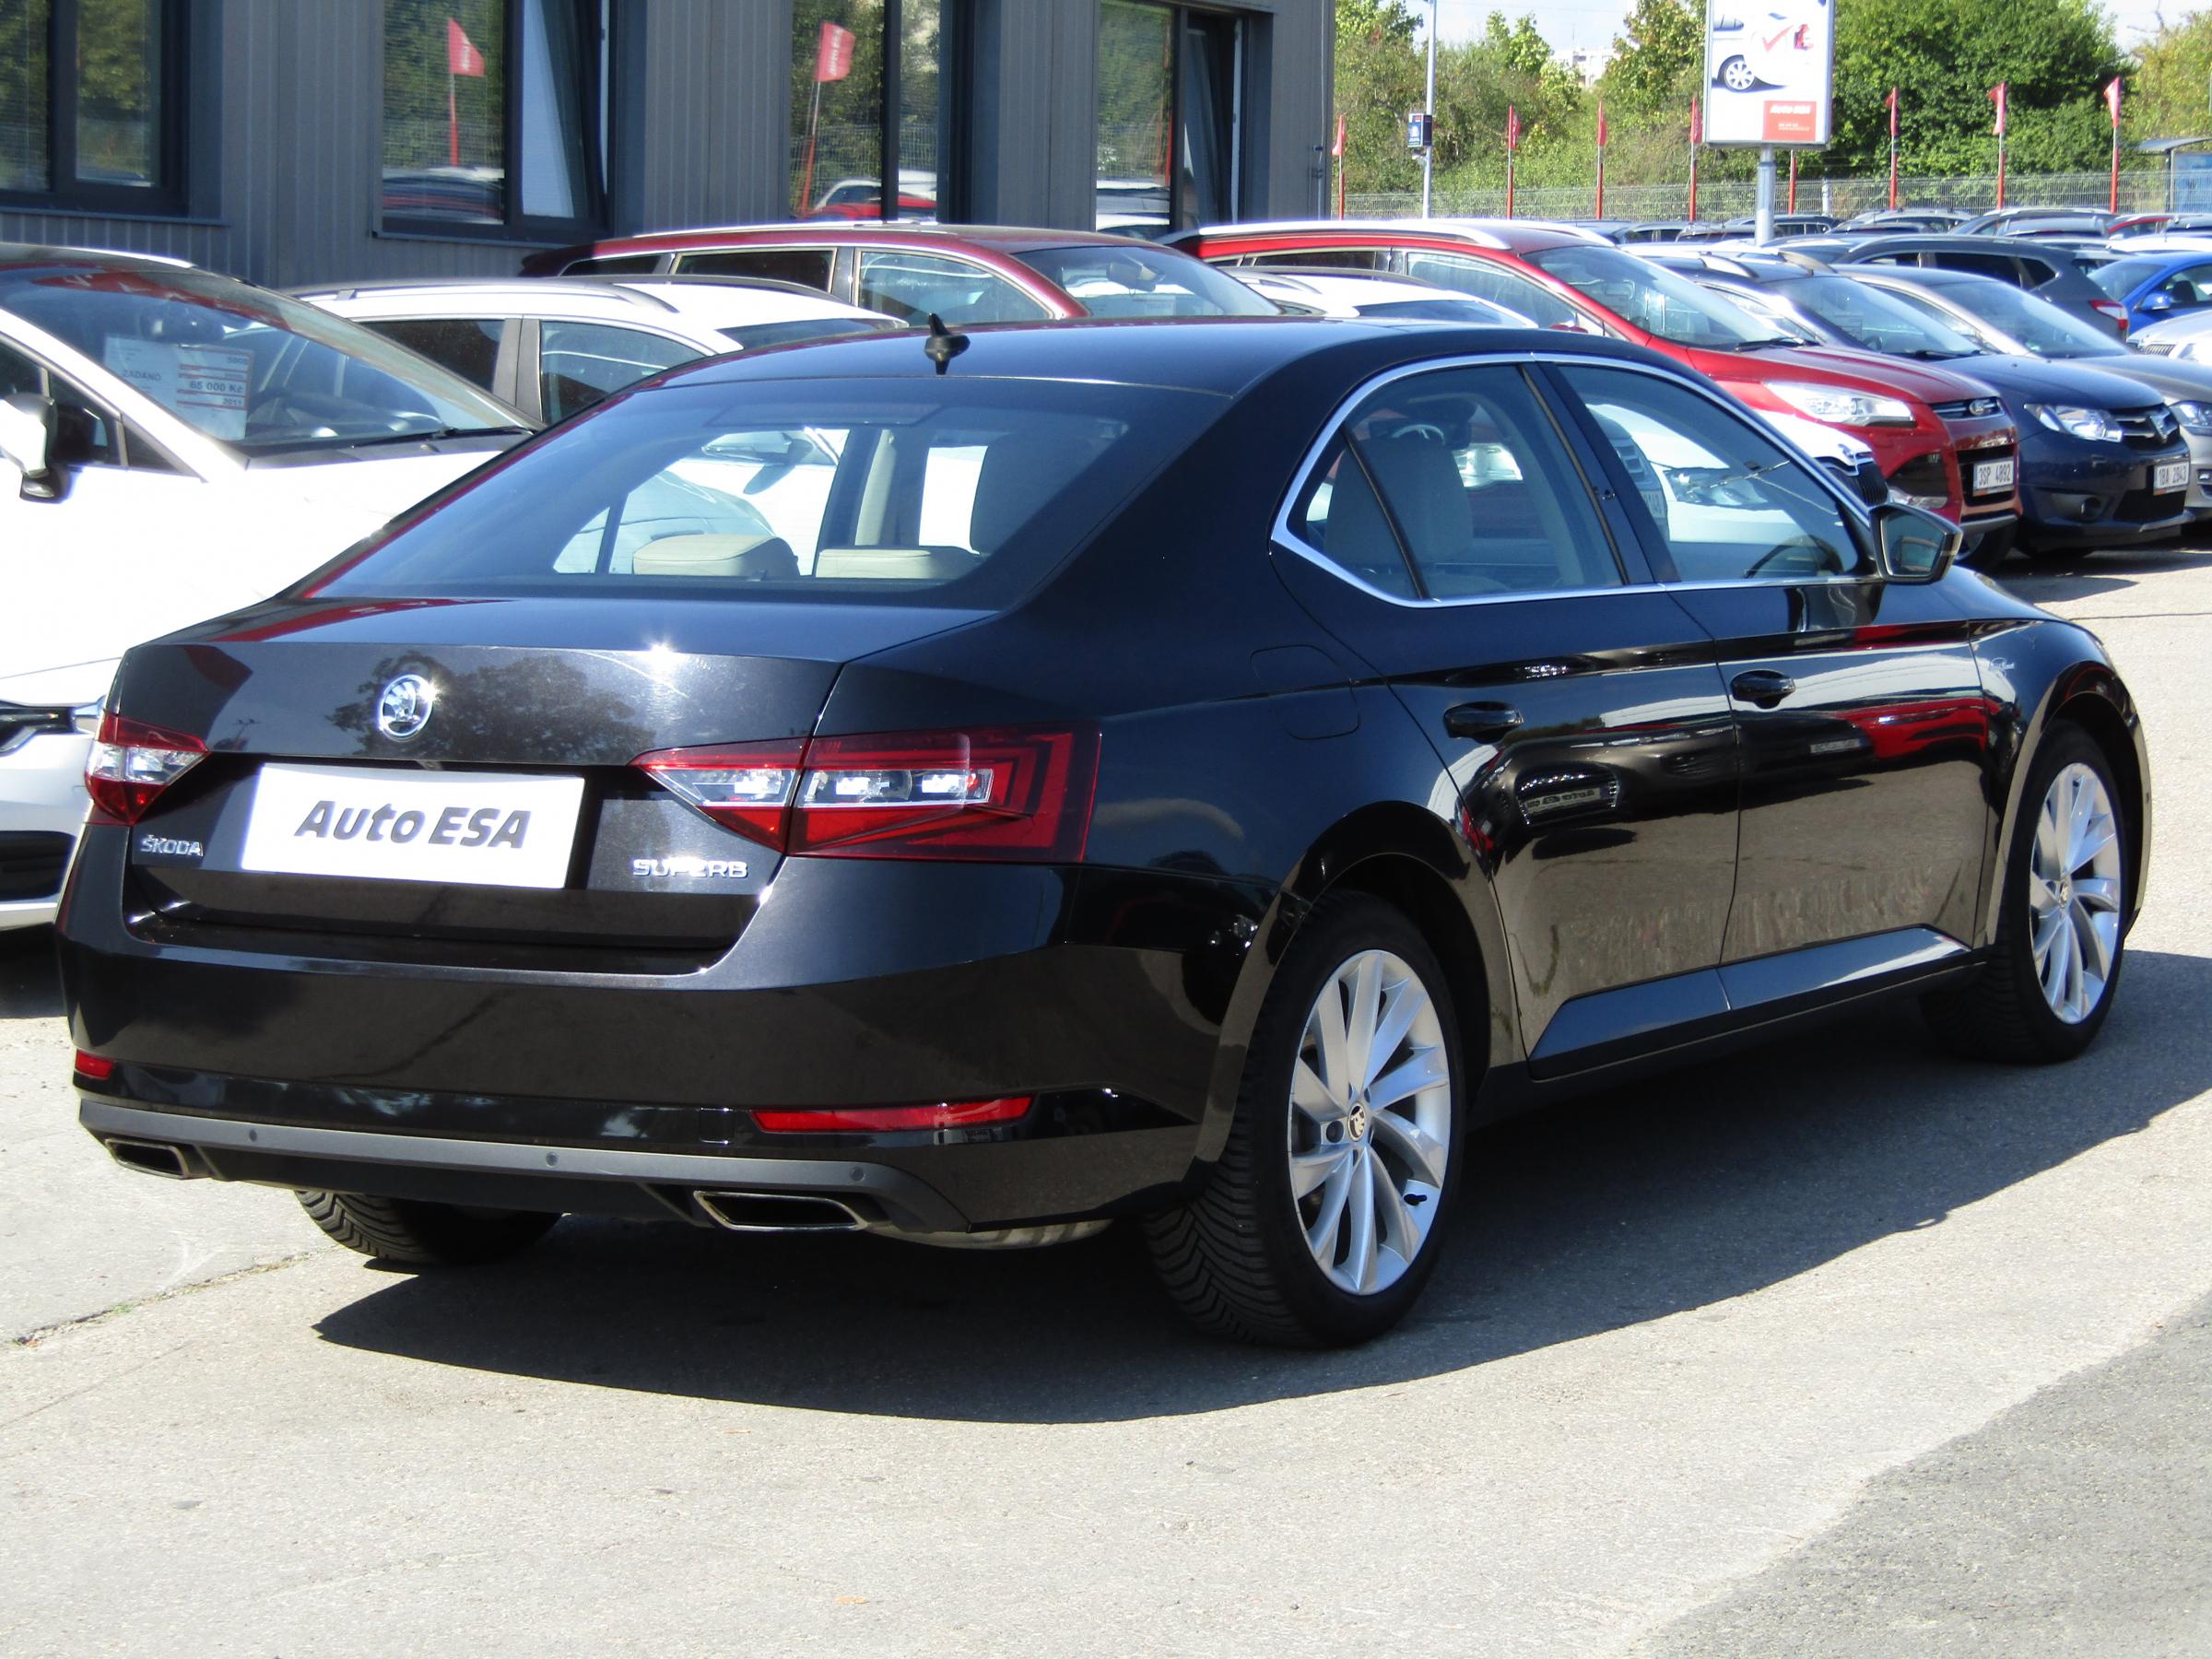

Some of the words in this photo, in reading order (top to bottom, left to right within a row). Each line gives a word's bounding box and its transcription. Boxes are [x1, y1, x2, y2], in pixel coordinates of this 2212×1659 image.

[293, 799, 426, 844] Auto
[427, 806, 532, 849] ESA
[140, 833, 204, 857] ŠKODA
[632, 856, 749, 879] SUPERB
